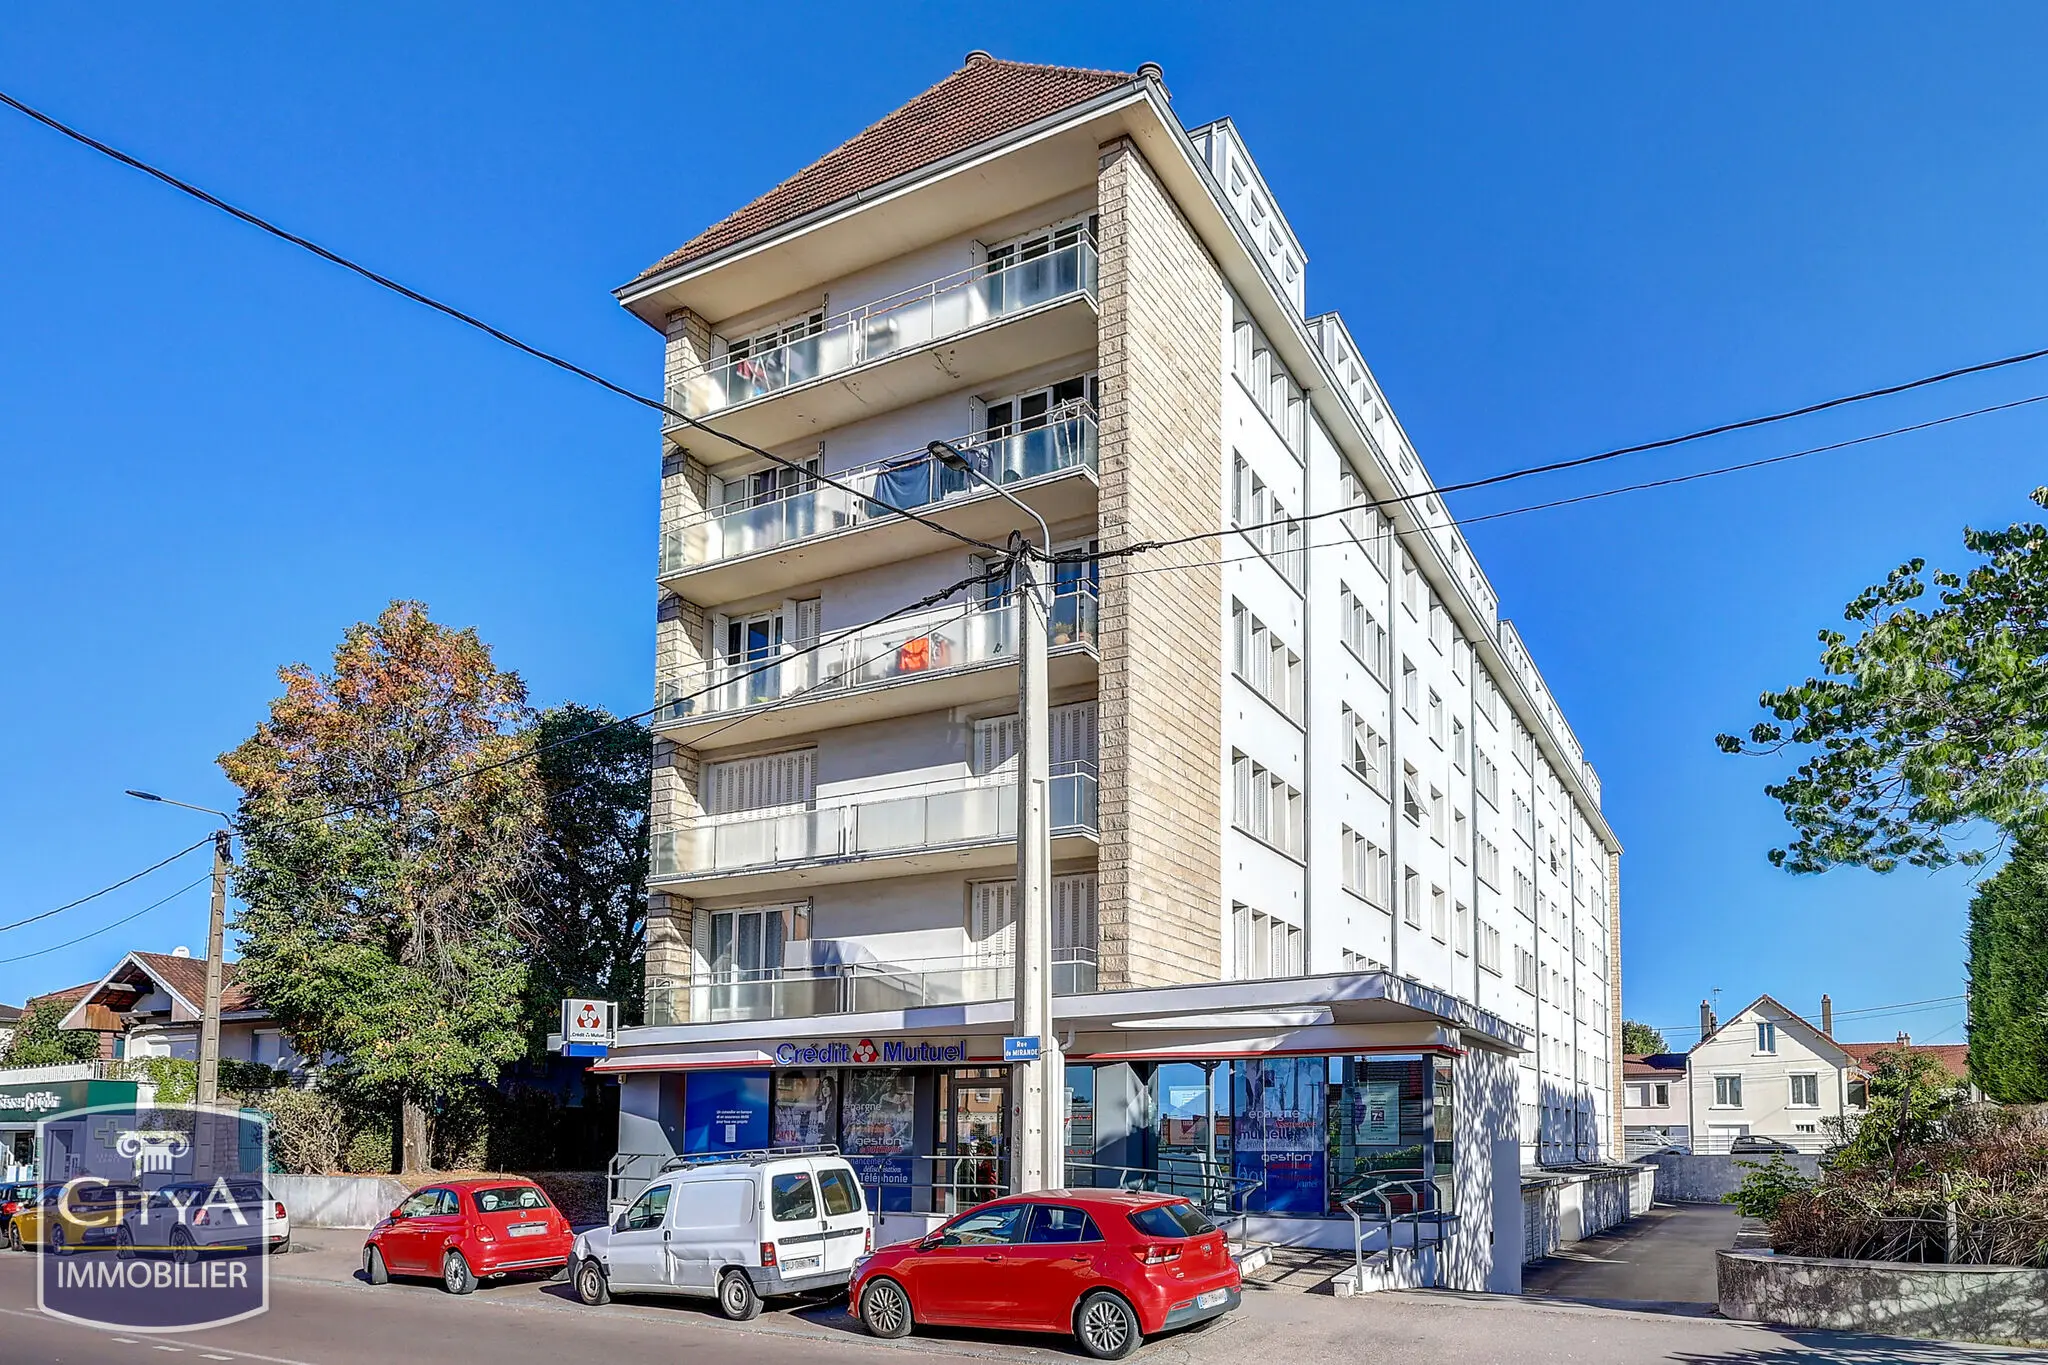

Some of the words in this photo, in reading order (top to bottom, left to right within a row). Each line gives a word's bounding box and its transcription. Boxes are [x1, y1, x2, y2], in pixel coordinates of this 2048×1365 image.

[776, 1042, 849, 1065] Crédit
[883, 1040, 967, 1063] Mutuel
[856, 1136, 902, 1147] gestion
[1261, 1152, 1312, 1162] gestion
